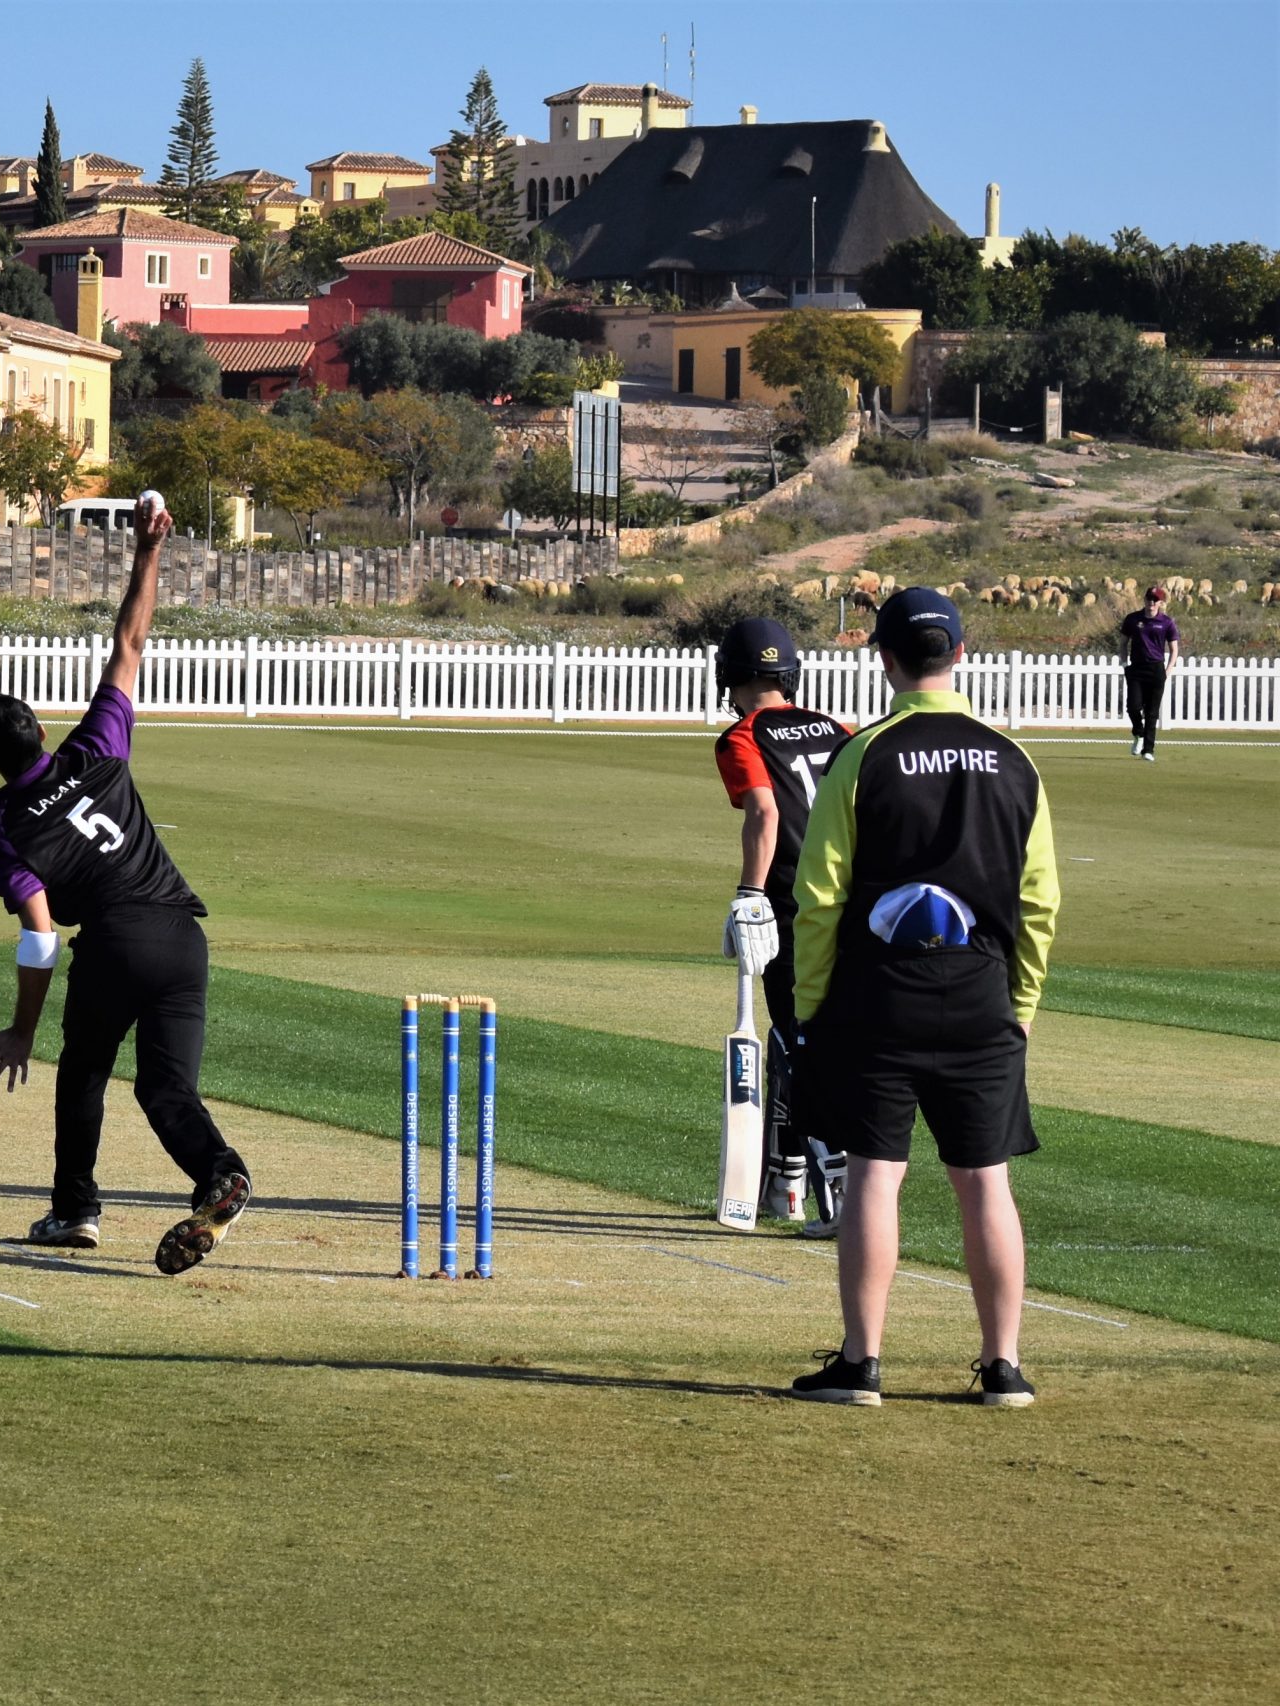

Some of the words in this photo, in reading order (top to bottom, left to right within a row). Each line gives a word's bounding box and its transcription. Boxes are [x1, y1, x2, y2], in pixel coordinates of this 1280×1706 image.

[766, 721, 835, 741] WESTON
[898, 748, 999, 775] UMPIRE
[65, 795, 125, 853] 5
[737, 1044, 756, 1090] BEAR
[406, 1092, 417, 1139] DESERT
[447, 1094, 457, 1140] DESERT
[483, 1095, 493, 1140] DESERT
[406, 1140, 417, 1190] SPRINGS
[447, 1142, 457, 1192] SPRINGS
[482, 1142, 493, 1192] SPRINGS
[406, 1193, 417, 1210] CC
[447, 1195, 456, 1212] CC
[481, 1195, 491, 1212] CC
[725, 1199, 754, 1220] BEAR
